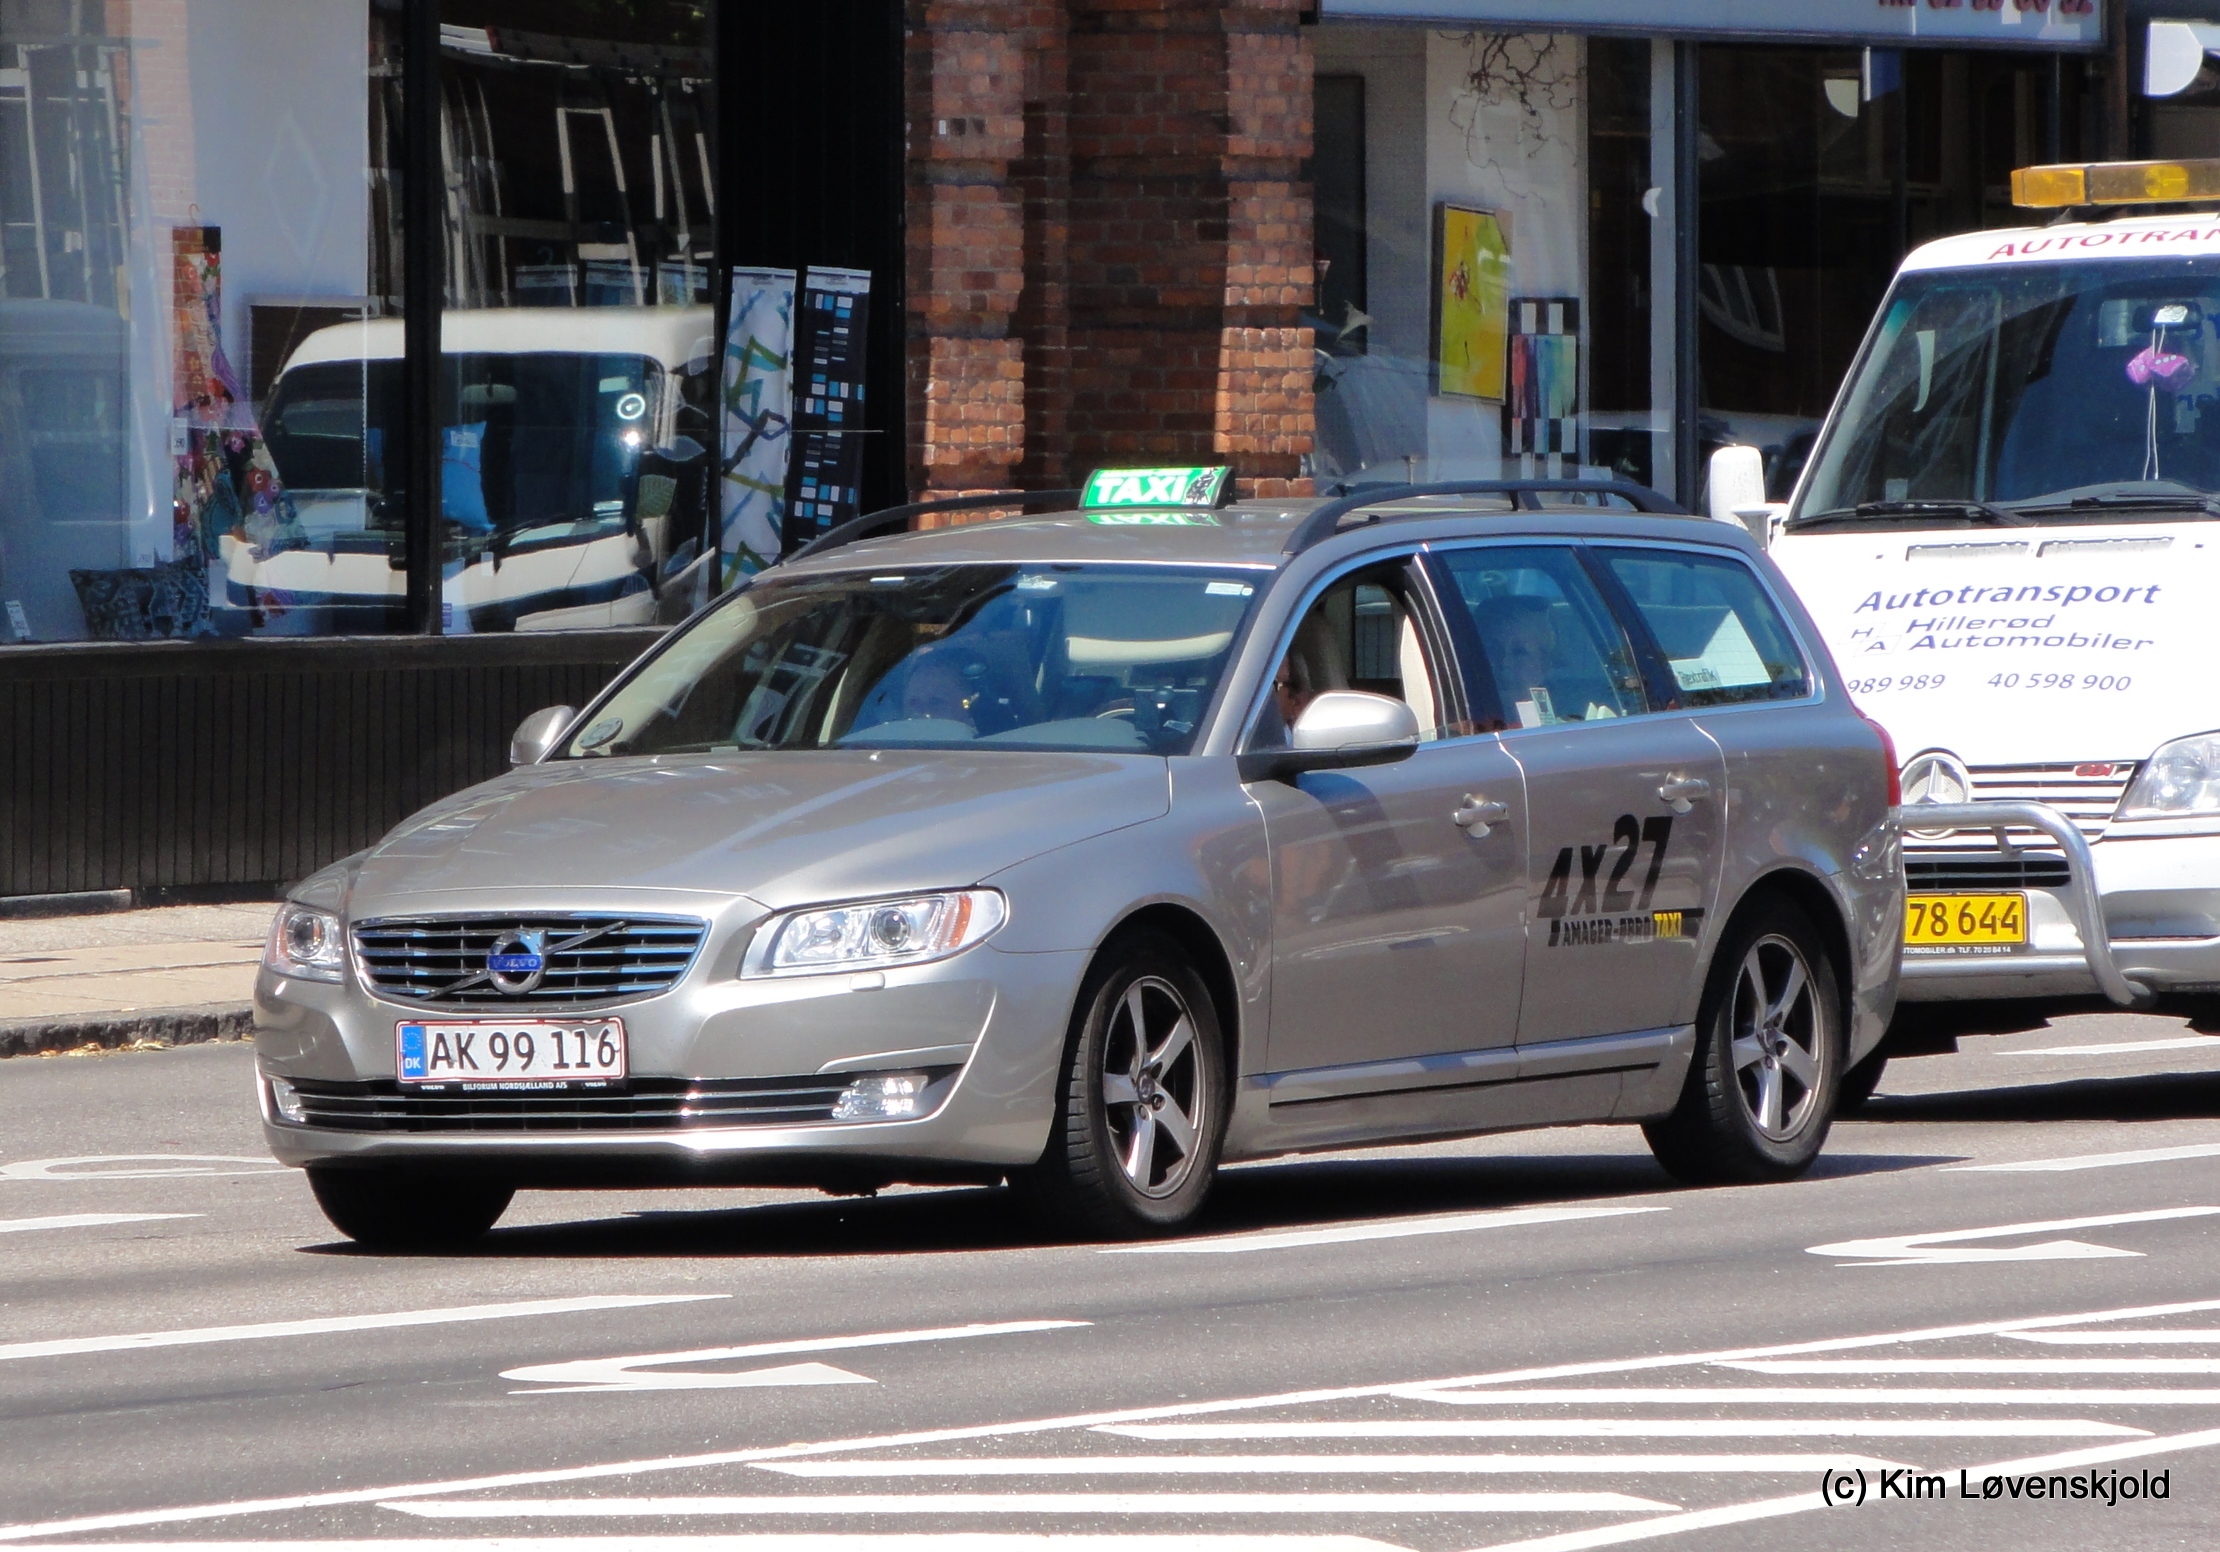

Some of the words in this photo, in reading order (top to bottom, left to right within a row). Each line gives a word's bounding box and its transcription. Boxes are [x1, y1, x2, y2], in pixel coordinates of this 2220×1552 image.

[1095, 476, 1188, 504] TAXI
[1853, 585, 2162, 613] Autotransport
[1906, 614, 2056, 634] Hillerød
[1909, 632, 2155, 651] Automobiler
[1899, 674, 1946, 690] 989
[1987, 673, 2020, 688] 40
[2025, 673, 2076, 690] 598
[2081, 675, 2132, 692] 900
[1653, 912, 1683, 938] TAXI
[1909, 902, 1949, 936] 78
[1958, 901, 2019, 936] 644
[430, 1032, 480, 1070] AK
[489, 1031, 535, 1072] 99
[551, 1028, 616, 1068] 116
[404, 1057, 421, 1069] DK
[463, 1083, 497, 1091] BILFORUM
[500, 1081, 553, 1090] NORDSJÆLLAND
[556, 1081, 568, 1089] A/S
